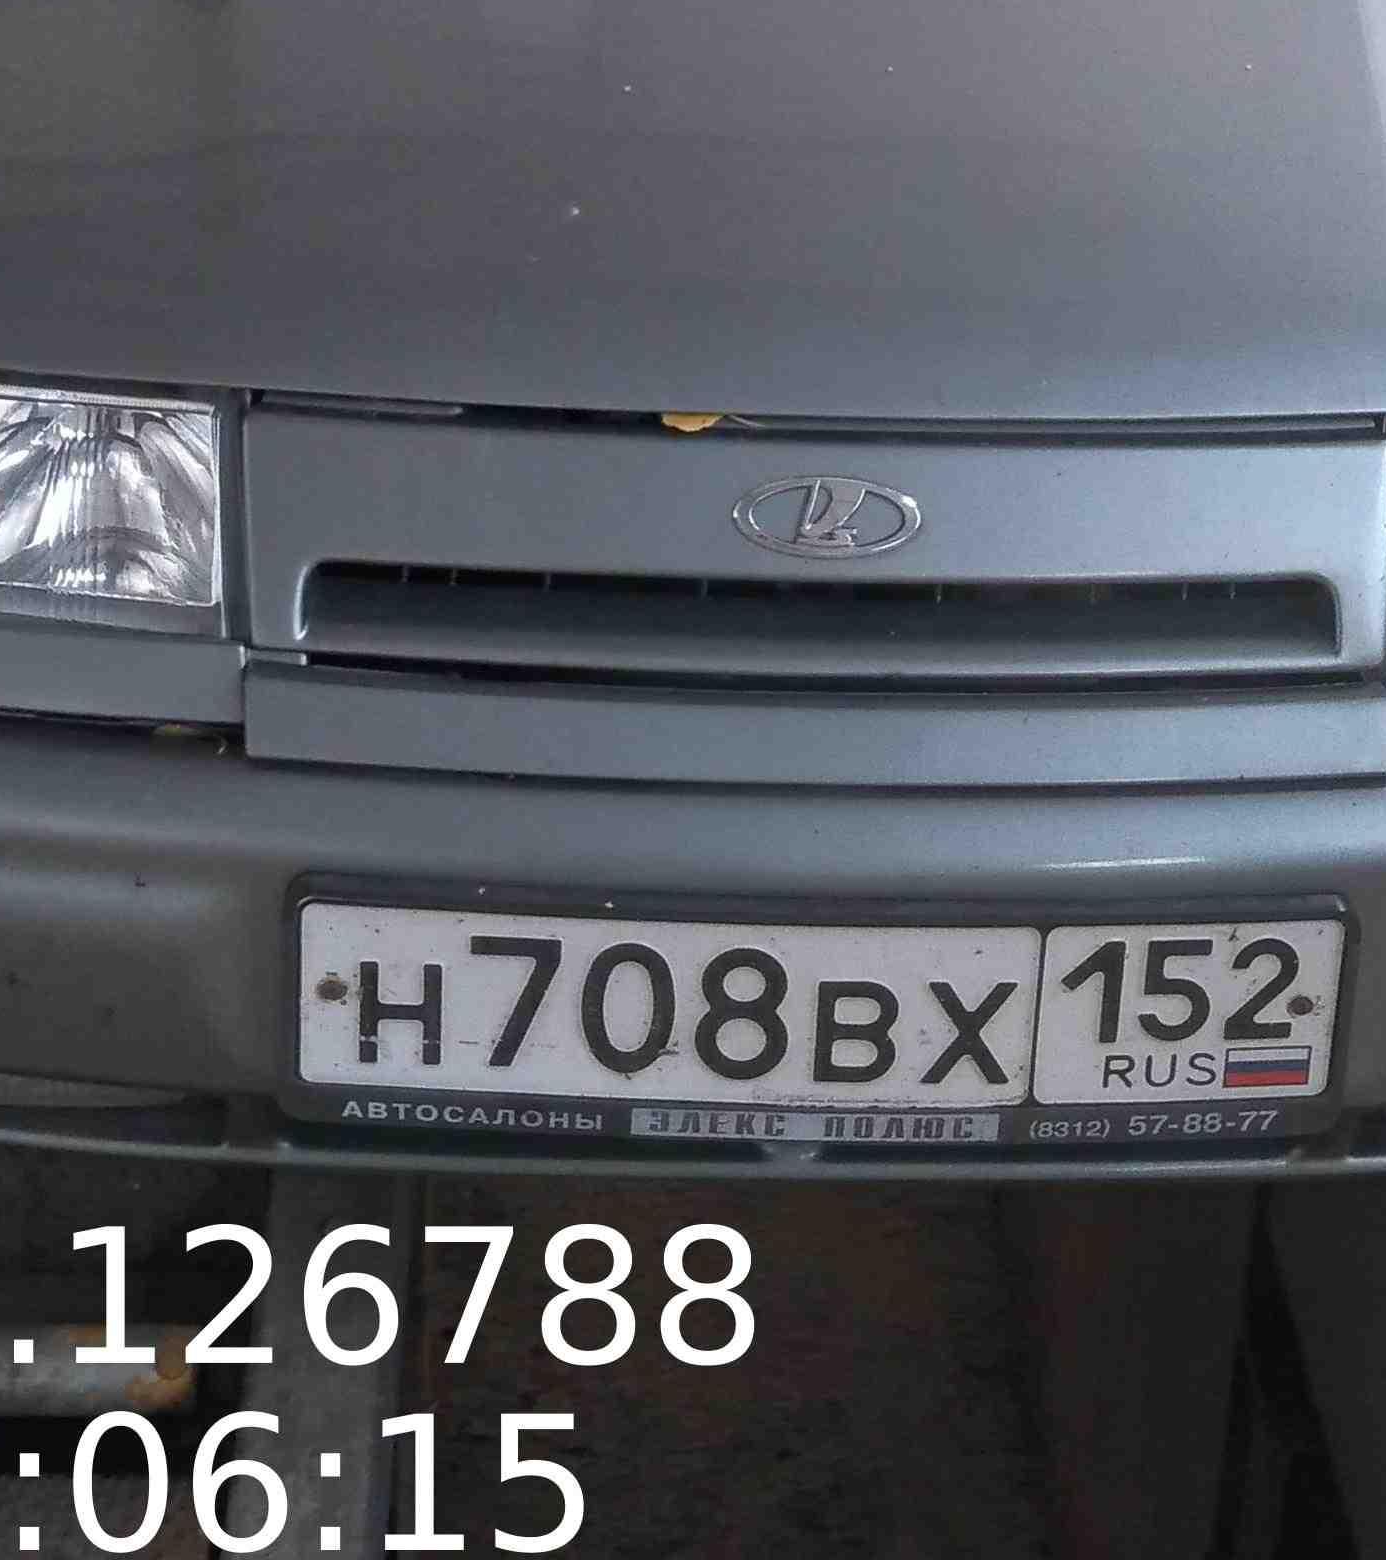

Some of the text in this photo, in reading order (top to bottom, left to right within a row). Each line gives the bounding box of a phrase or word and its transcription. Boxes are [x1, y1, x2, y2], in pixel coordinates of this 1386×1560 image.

[359, 935, 1299, 1084] Н708ВХ 152
[1102, 1053, 1217, 1088] RUS
[341, 1100, 604, 1131] АВТОСАЛОНЫ
[649, 1111, 787, 1137] ЭЛЕКС
[823, 1116, 975, 1140] ПОЛЮС
[1029, 1118, 1111, 1140] (8312)
